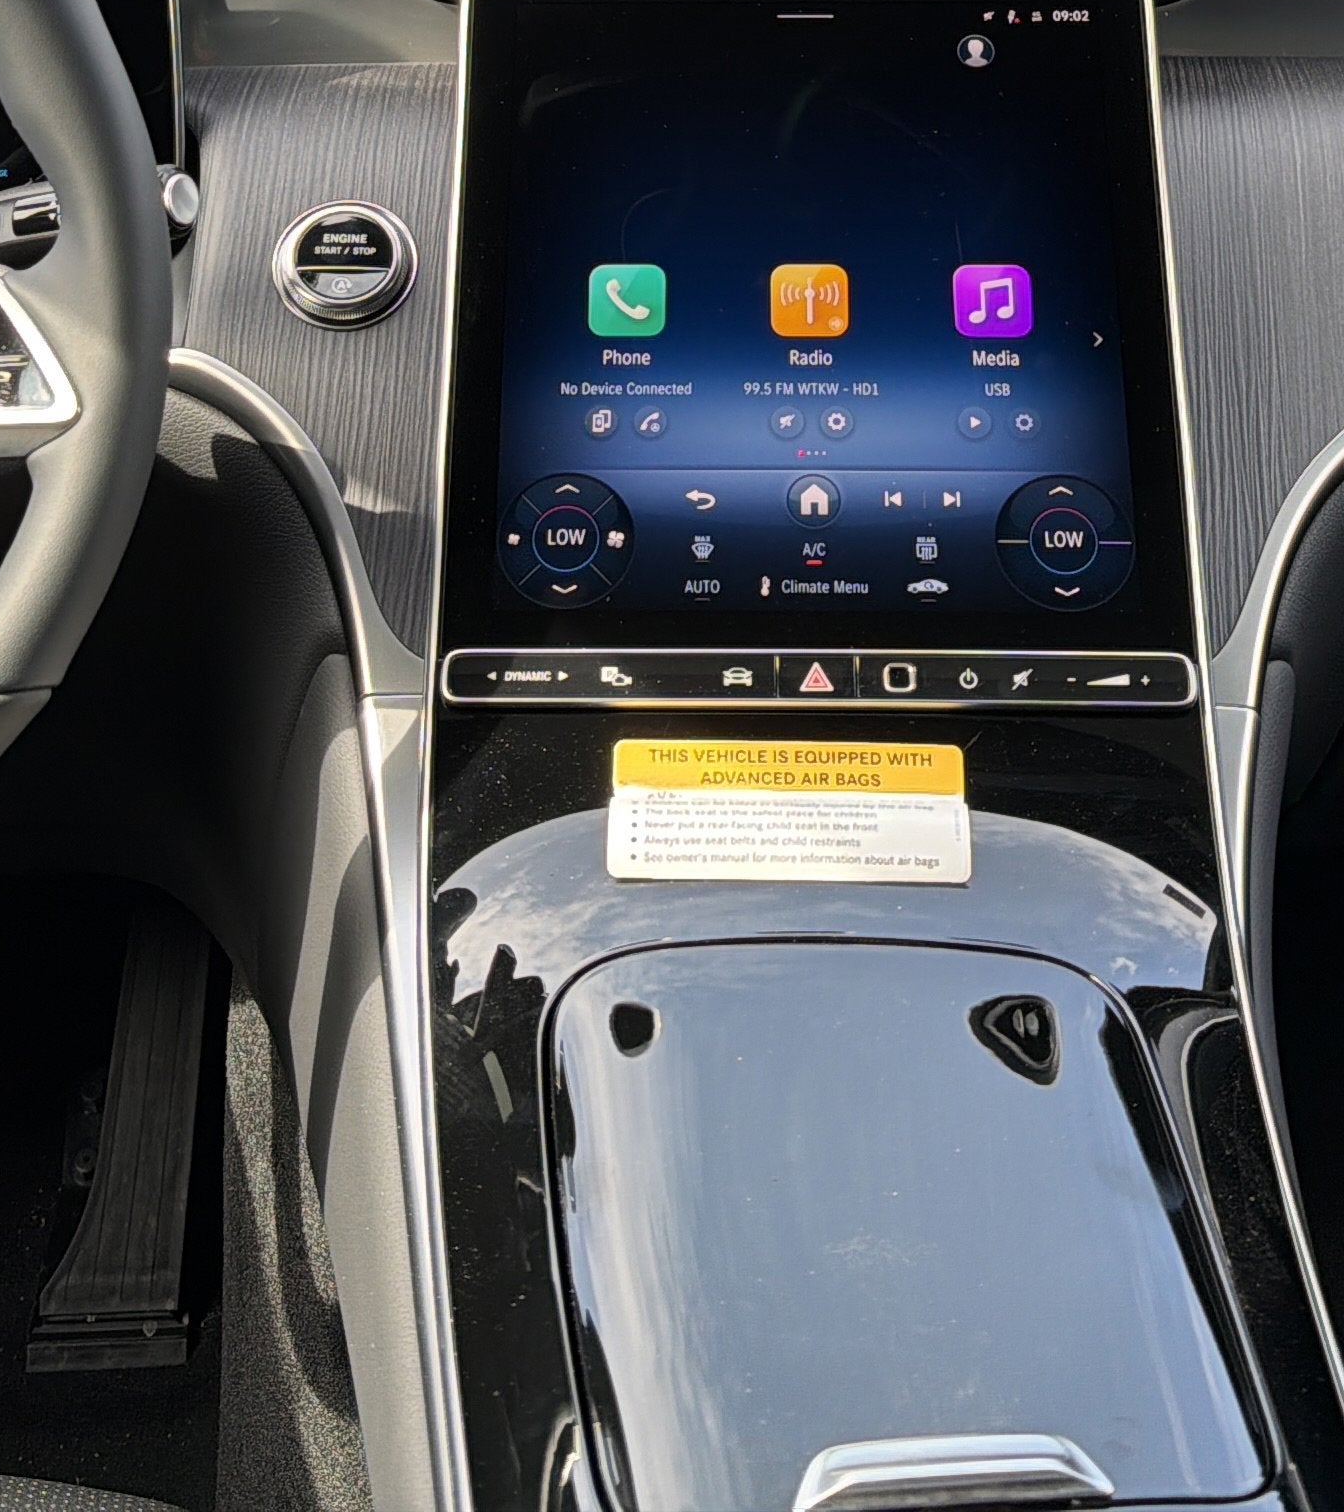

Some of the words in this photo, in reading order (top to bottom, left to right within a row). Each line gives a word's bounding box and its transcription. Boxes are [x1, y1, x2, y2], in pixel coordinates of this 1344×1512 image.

[1052, 9, 1090, 23] 09:02
[322, 233, 368, 244] ENGINE
[314, 245, 342, 255] START
[352, 245, 377, 256] STOP
[602, 349, 651, 366] Phone
[789, 349, 833, 366] Radio
[972, 350, 1020, 366] Media
[560, 381, 578, 396] No
[582, 381, 622, 396] Device
[626, 380, 692, 397] Connected
[743, 382, 771, 396] 99.5
[775, 382, 794, 396] FM
[797, 382, 839, 396] WTKW
[852, 382, 879, 396] HD1
[984, 382, 1011, 397] USB
[547, 528, 586, 546] LOW
[1044, 530, 1083, 549] LOW
[803, 542, 826, 557] A/C
[684, 579, 721, 594] AUTO
[781, 579, 830, 595] Climate
[834, 580, 869, 595] Menu
[504, 670, 552, 682] DYNAMIC
[649, 748, 688, 763] THIS
[695, 749, 767, 764] VEHICLE
[772, 749, 789, 764] IS
[794, 750, 882, 766] EQUIPPED
[887, 752, 933, 768] WITH
[700, 772, 796, 786] ADVANCED
[801, 772, 830, 787] AIR
[836, 773, 882, 787] BAGS
[644, 820, 674, 829] Never
[730, 821, 763, 832] facing
[766, 822, 792, 831] child
[832, 823, 850, 832] the
[852, 823, 878, 832] front
[644, 835, 680, 847] Always
[706, 836, 728, 845] seat
[731, 836, 756, 846] belts
[760, 837, 779, 846] and
[782, 837, 807, 846] child
[810, 838, 861, 848] restraints
[644, 851, 664, 863] See
[666, 853, 708, 863] owner's
[710, 852, 750, 863] manual
[752, 852, 768, 863] for
[770, 854, 798, 864] more
[800, 853, 862, 865] information
[864, 855, 895, 866] about
[897, 856, 912, 866] air
[914, 856, 940, 869] bags
